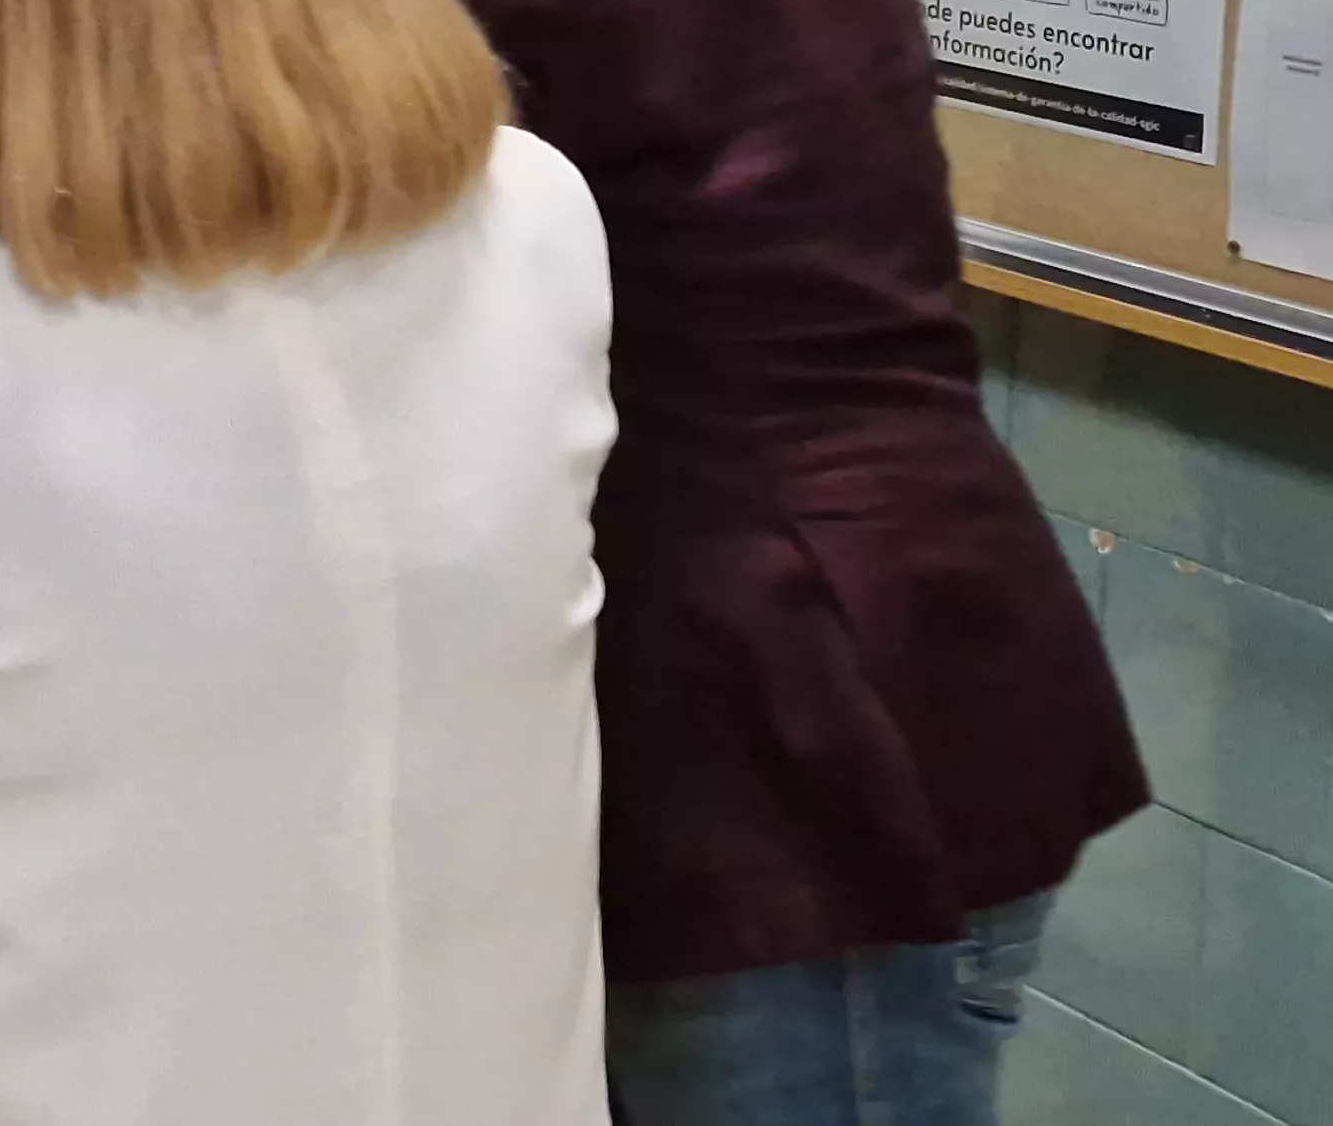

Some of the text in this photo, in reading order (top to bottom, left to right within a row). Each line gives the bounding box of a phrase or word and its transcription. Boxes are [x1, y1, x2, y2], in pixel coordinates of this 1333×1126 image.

[1096, 0, 1159, 15] compartido
[959, 11, 1036, 39] puedes
[1043, 25, 1155, 62] encontrar
